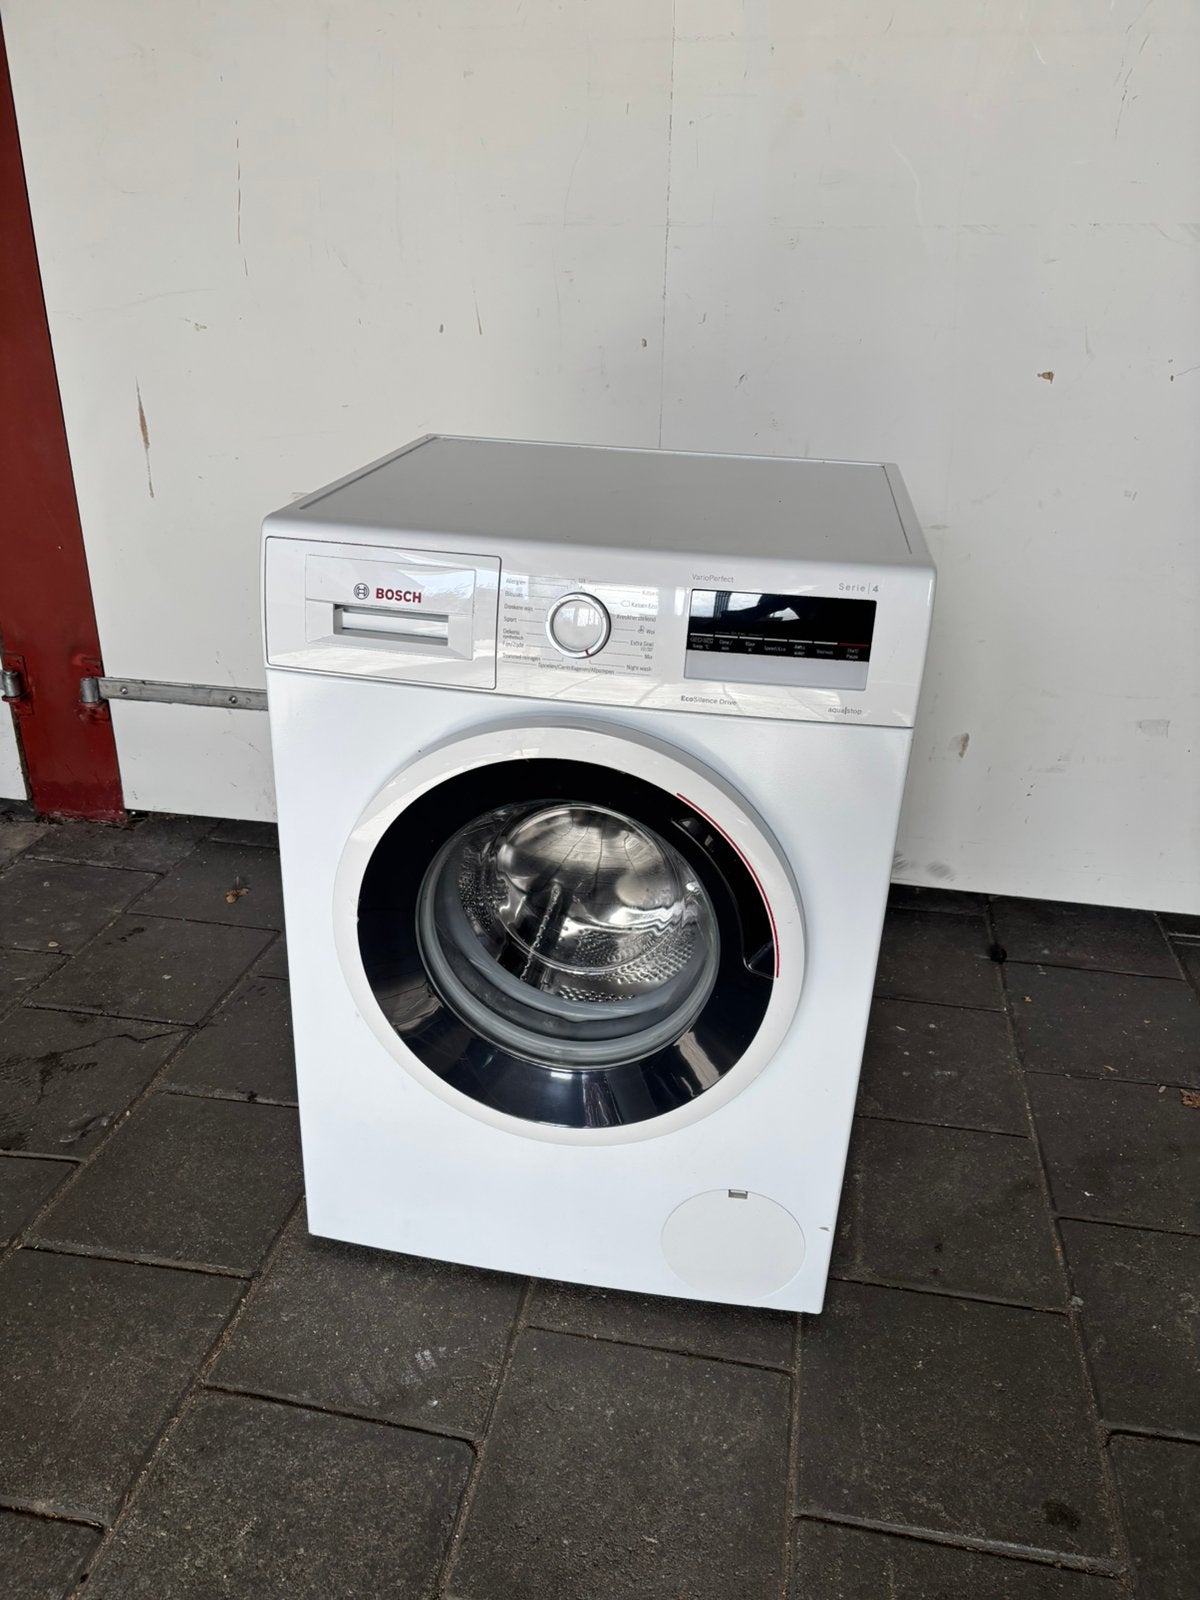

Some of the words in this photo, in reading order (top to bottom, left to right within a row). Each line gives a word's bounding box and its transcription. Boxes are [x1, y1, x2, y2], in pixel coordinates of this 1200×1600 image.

[691, 574, 734, 584] VarioPerfect
[838, 582, 866, 593] Serie
[872, 585, 879, 593] 4
[375, 587, 422, 604] BOSCH
[503, 616, 518, 624] Sport
[680, 695, 718, 705] EcoSilence
[718, 698, 737, 707] Drive
